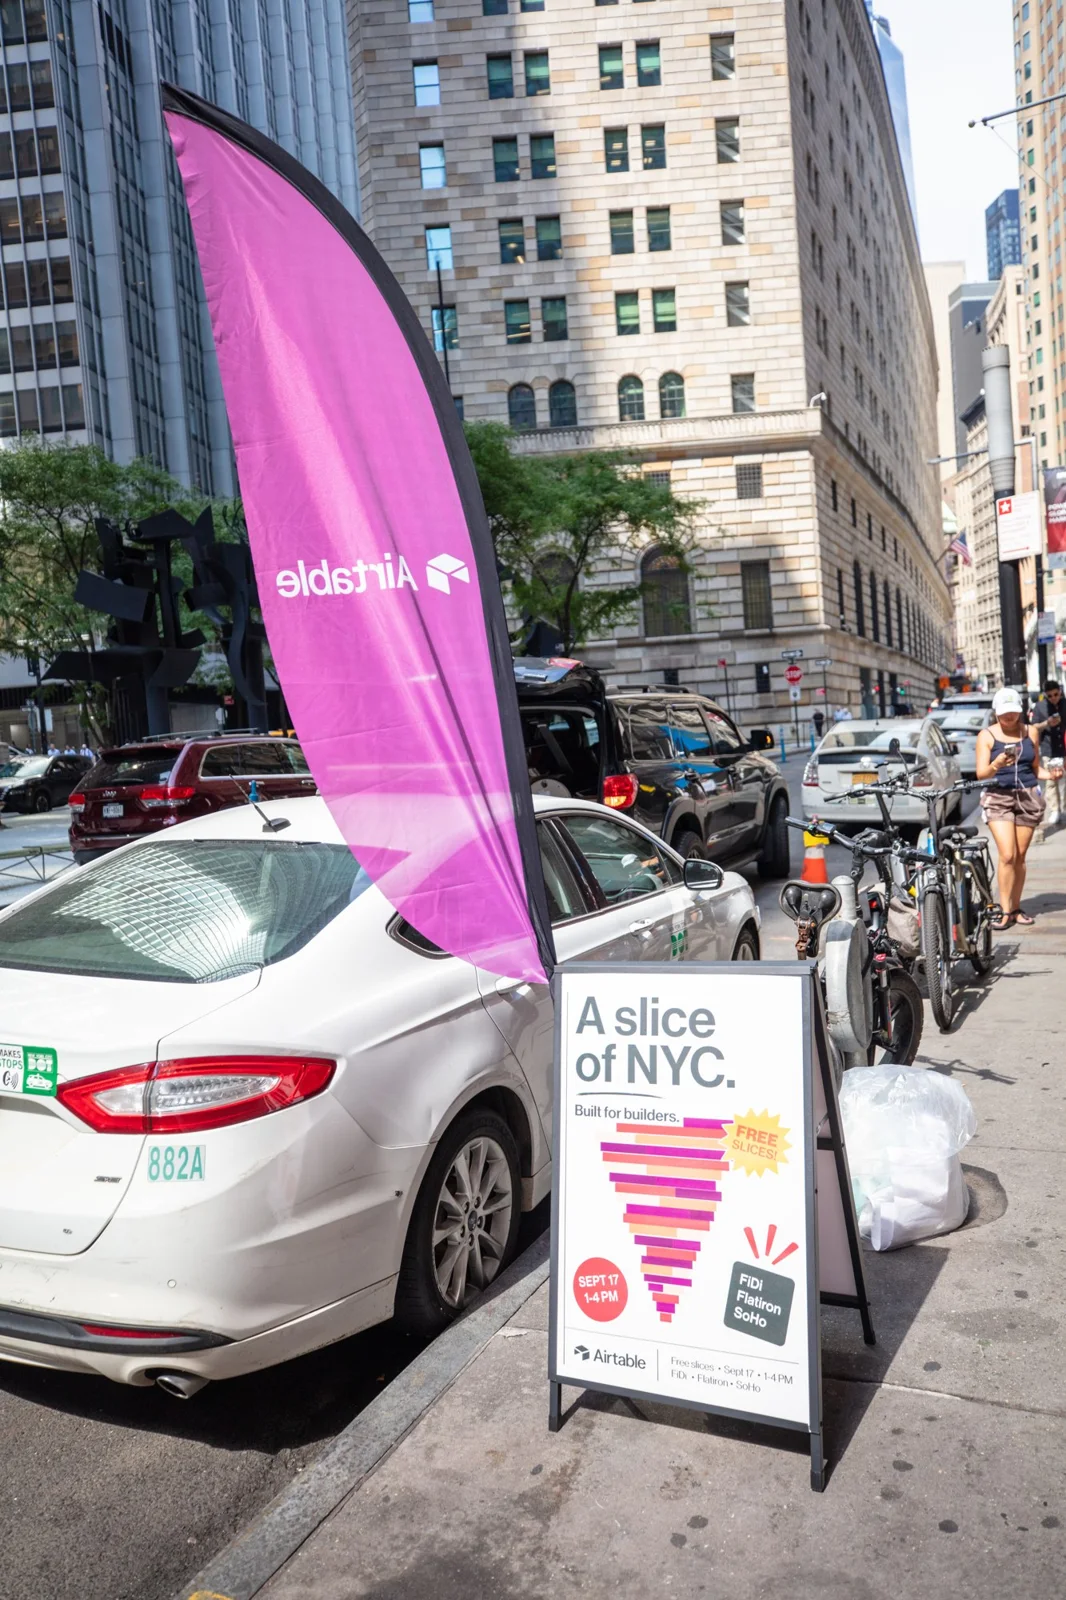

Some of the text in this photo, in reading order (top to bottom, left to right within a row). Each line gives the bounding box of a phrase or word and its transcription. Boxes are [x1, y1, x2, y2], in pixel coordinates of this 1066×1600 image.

[785, 669, 803, 679] STOP
[575, 996, 716, 1038] A slice
[0, 1058, 23, 1070] TOPS
[575, 1043, 736, 1088] of NYC.
[574, 1104, 680, 1122] Built for builders.
[736, 1124, 779, 1148] FREE
[731, 1139, 778, 1161] SLICES!
[148, 1146, 203, 1181] 882A
[578, 1273, 619, 1288] SEPT 17
[739, 1273, 764, 1292] FiDi
[584, 1290, 619, 1304] 1-4 PM
[736, 1289, 782, 1316] Flatiron
[733, 1306, 767, 1328] SoHo
[594, 1348, 647, 1370] Airtable
[671, 1356, 794, 1385] Free slices Sept 17 1-4 PM
[671, 1369, 761, 1393] FiDi Flatiron SoHo
